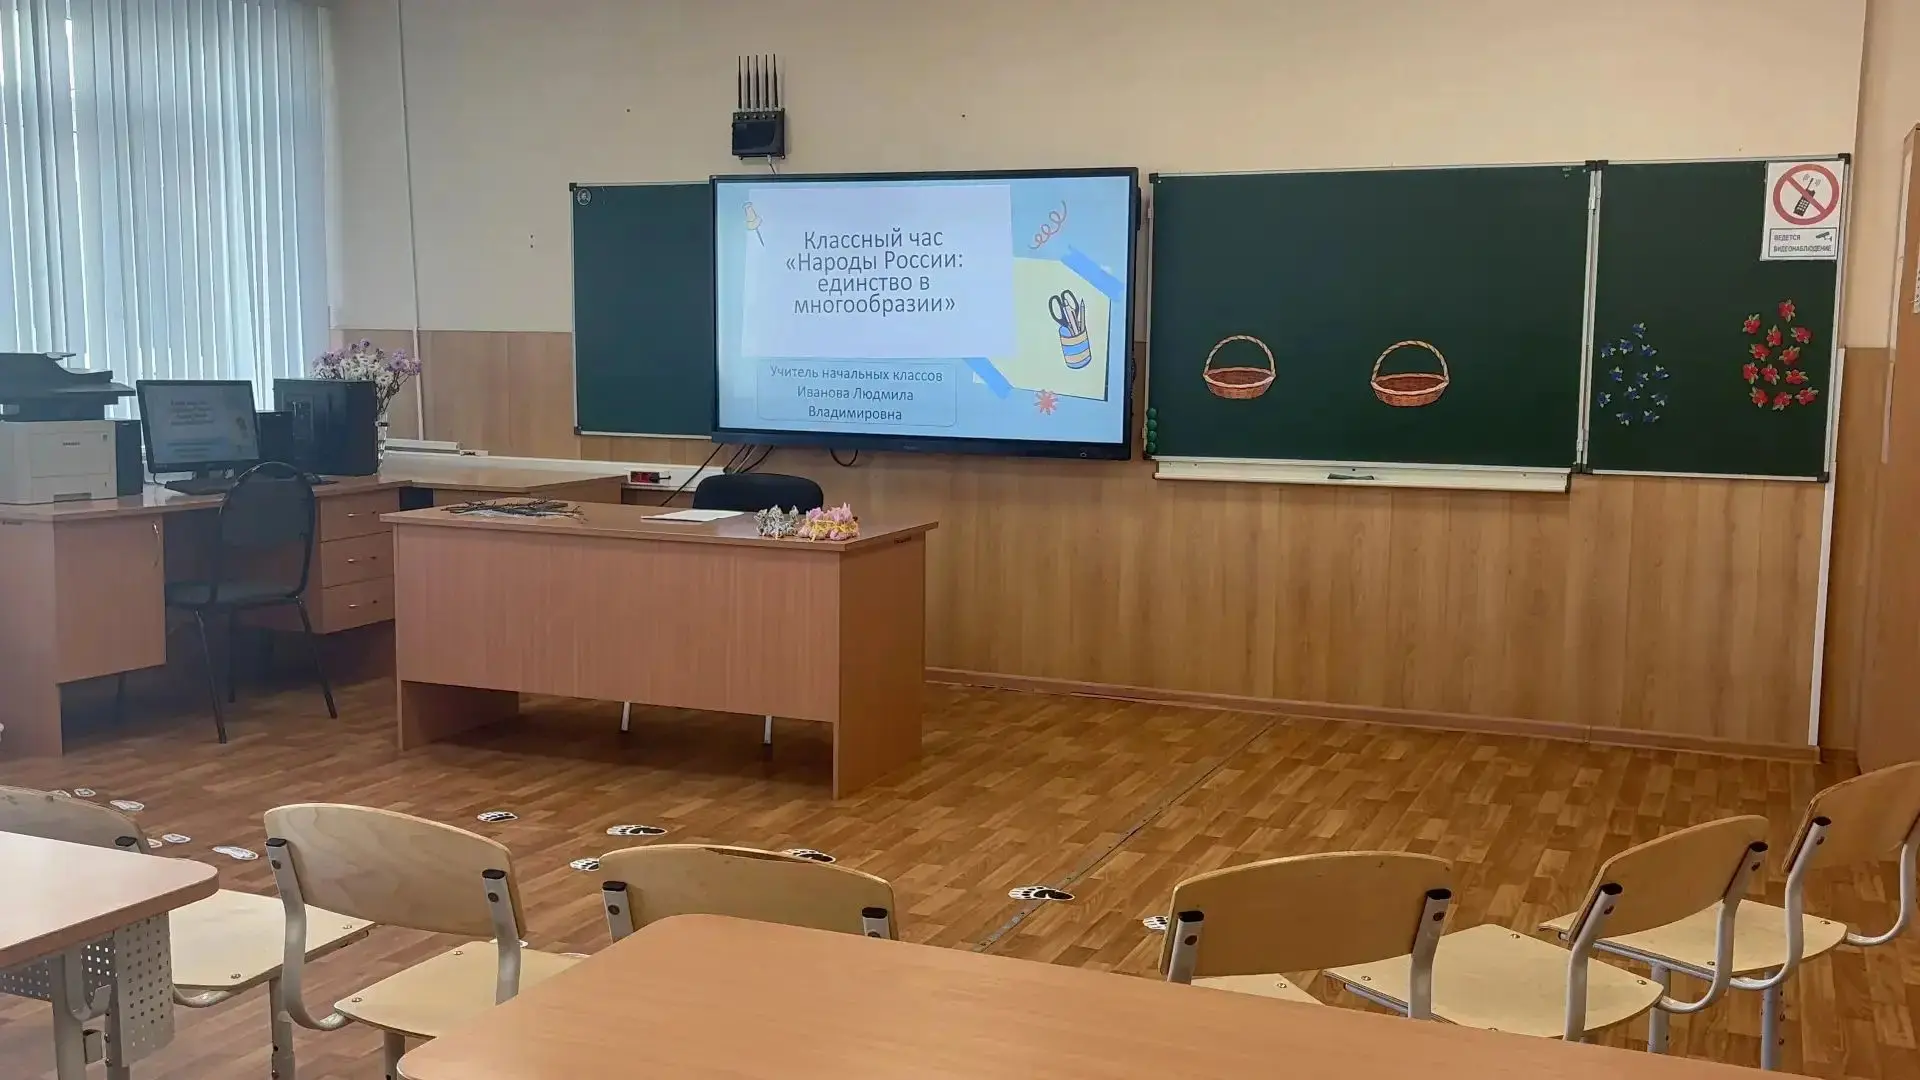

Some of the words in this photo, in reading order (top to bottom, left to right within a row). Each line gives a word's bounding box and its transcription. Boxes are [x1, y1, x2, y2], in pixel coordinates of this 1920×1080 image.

[804, 227, 903, 250] Классный
[909, 231, 944, 247] час
[786, 252, 877, 276] «Народы
[884, 250, 963, 270] России:
[818, 276, 913, 296] единство
[919, 276, 930, 291] в
[794, 293, 956, 317] многообразии»
[770, 365, 819, 379] Учитель
[822, 368, 890, 381] начальных
[893, 370, 943, 382] классов
[797, 385, 850, 399] Иванова
[853, 387, 914, 402] Людмила
[808, 405, 902, 422] Владимировна
